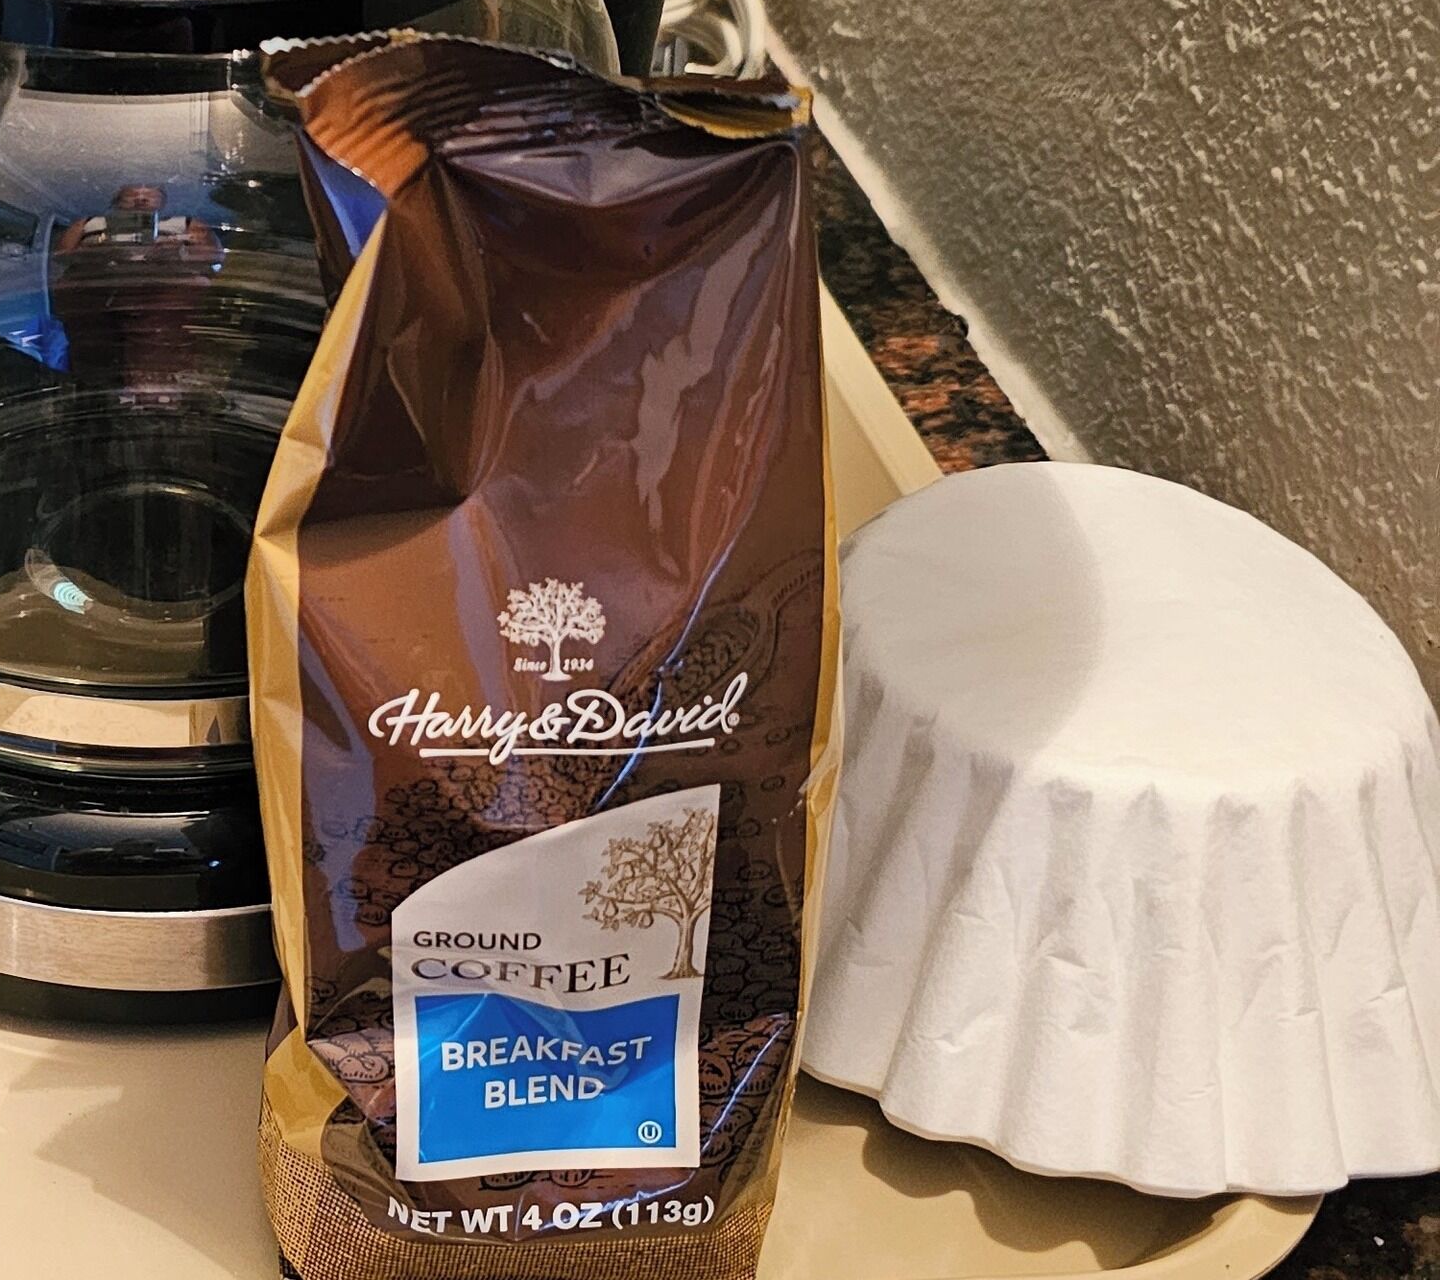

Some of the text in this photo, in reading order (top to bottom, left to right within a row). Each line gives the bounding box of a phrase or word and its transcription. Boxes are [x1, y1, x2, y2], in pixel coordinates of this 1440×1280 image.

[513, 657, 547, 672] Since
[413, 930, 542, 951] GROUND
[411, 953, 631, 994] COFFEE
[441, 1035, 652, 1072] BREAKFAST
[484, 1074, 606, 1109] BLEND
[387, 1195, 715, 1234] NET WT 4 OZ (113g)
